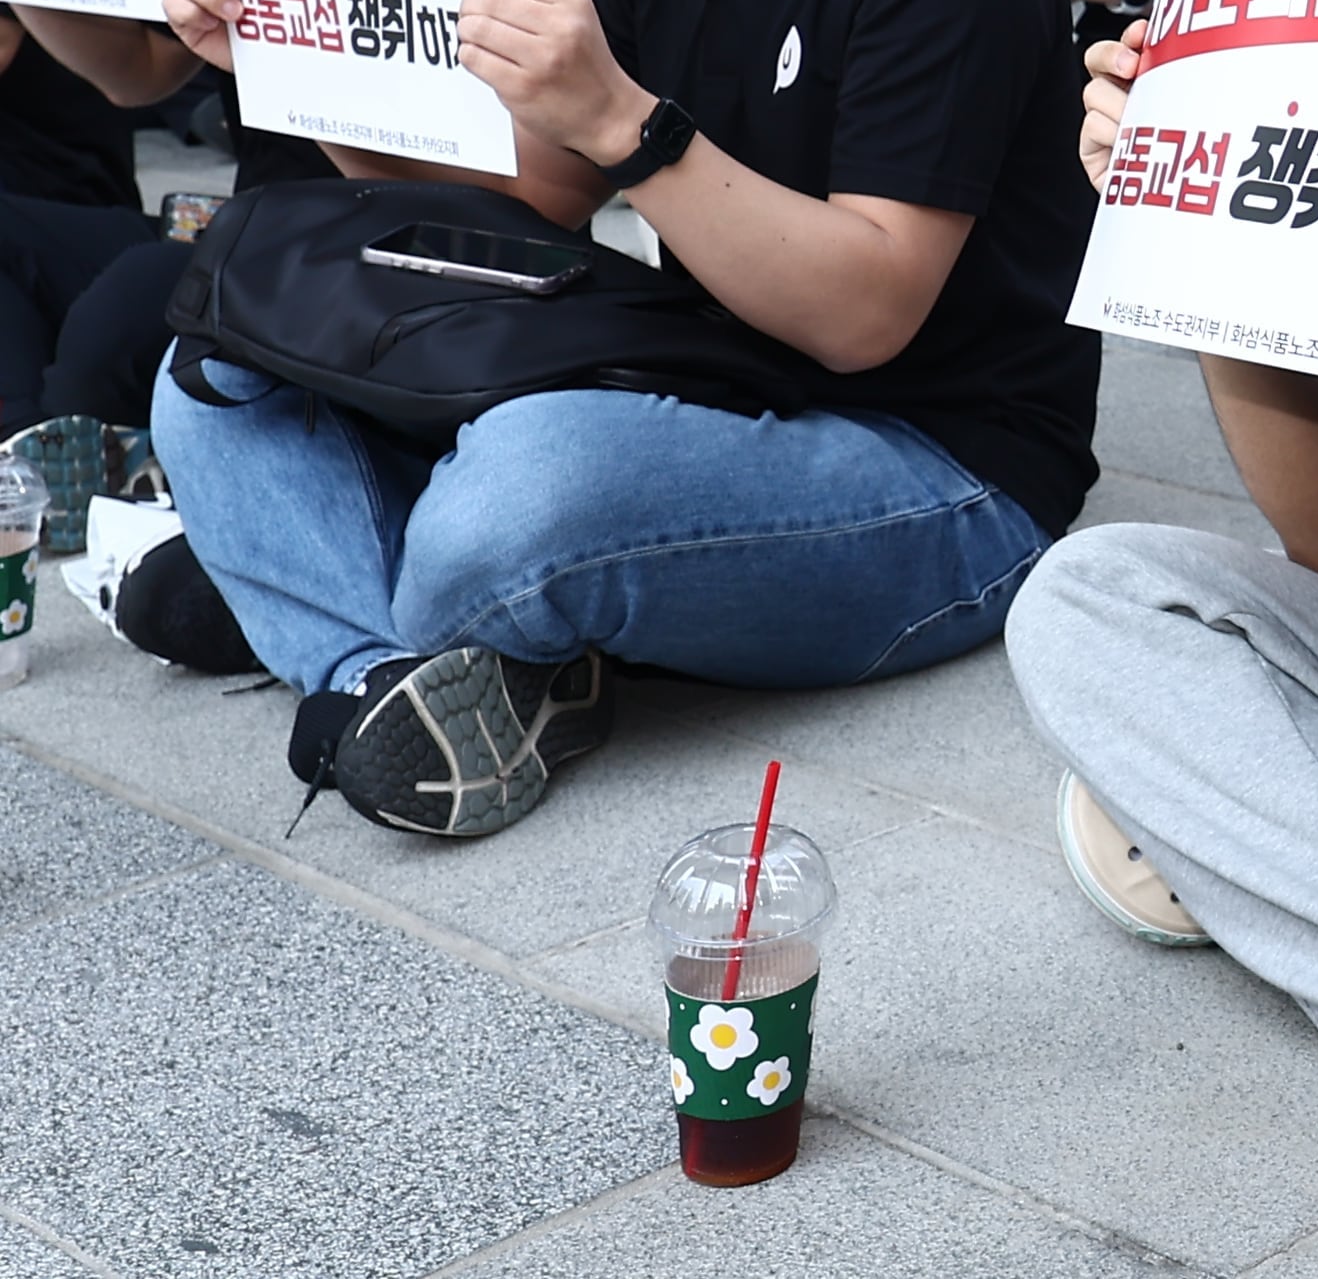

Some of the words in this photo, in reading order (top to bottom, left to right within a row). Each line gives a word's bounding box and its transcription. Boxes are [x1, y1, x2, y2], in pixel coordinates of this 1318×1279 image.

[1105, 126, 1232, 216] 공동교섭
[1113, 301, 1162, 328] 화섬식품노조
[1163, 310, 1221, 341] 수도권지부
